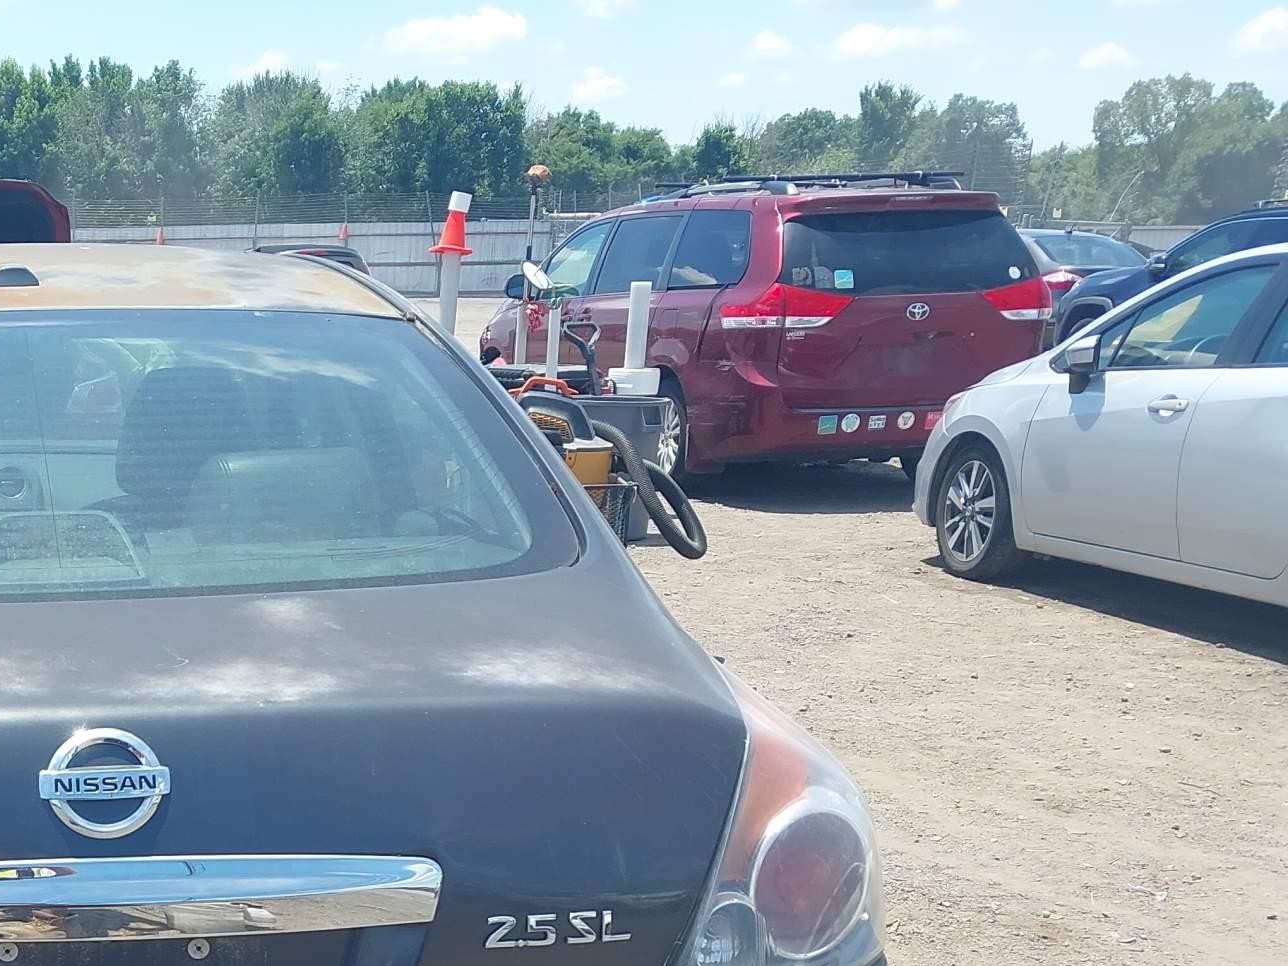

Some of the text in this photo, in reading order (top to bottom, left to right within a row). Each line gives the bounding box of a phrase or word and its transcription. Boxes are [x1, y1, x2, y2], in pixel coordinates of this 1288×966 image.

[54, 774, 157, 793] NISSAN
[485, 910, 632, 949] 2.5 SL
